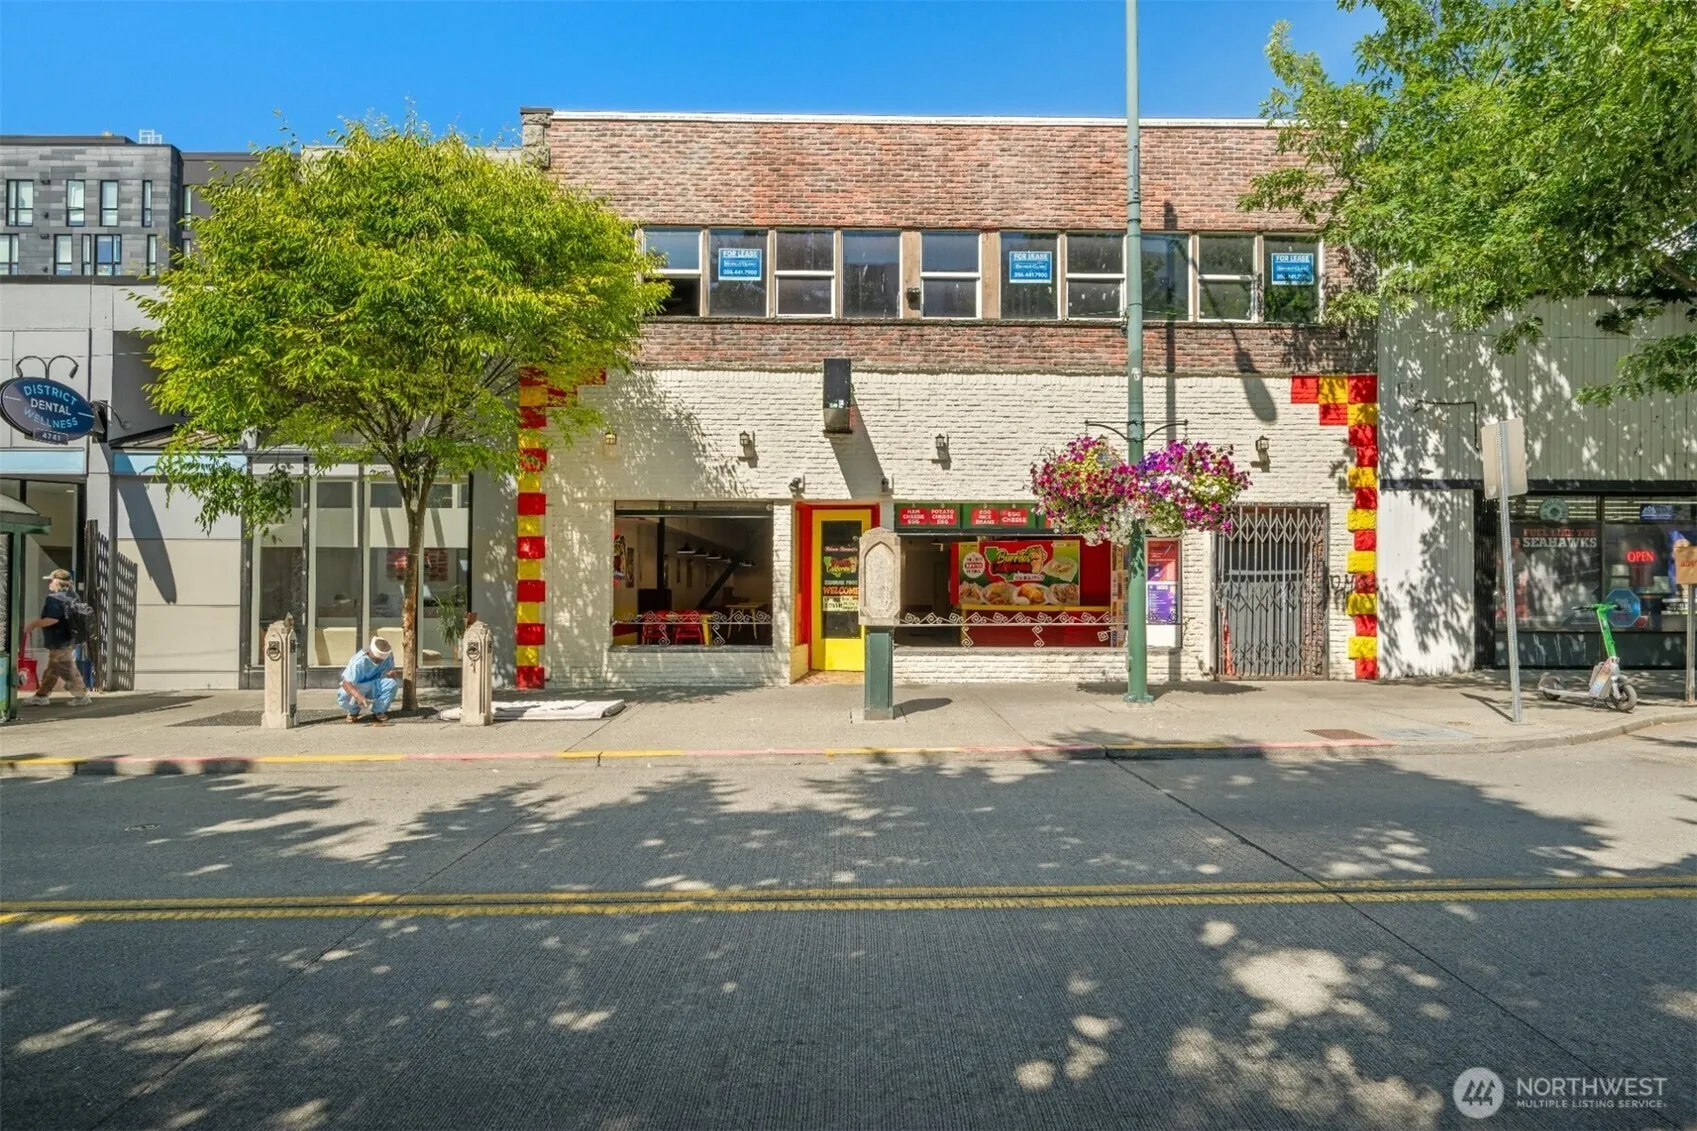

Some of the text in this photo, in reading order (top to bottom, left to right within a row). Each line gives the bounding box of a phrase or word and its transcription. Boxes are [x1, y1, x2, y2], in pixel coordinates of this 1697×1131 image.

[723, 250, 758, 258] FOR LEASE
[23, 384, 79, 406] DISTRICT
[30, 397, 72, 416] DENTAL
[23, 405, 79, 429] WELLNESS
[42, 431, 61, 440] 4741
[1523, 528, 1547, 537] FUEL
[1576, 528, 1596, 537] THE
[1523, 537, 1598, 548] SEAHAWKS
[1627, 551, 1655, 563] OPEN
[823, 586, 860, 595] WELCOME
